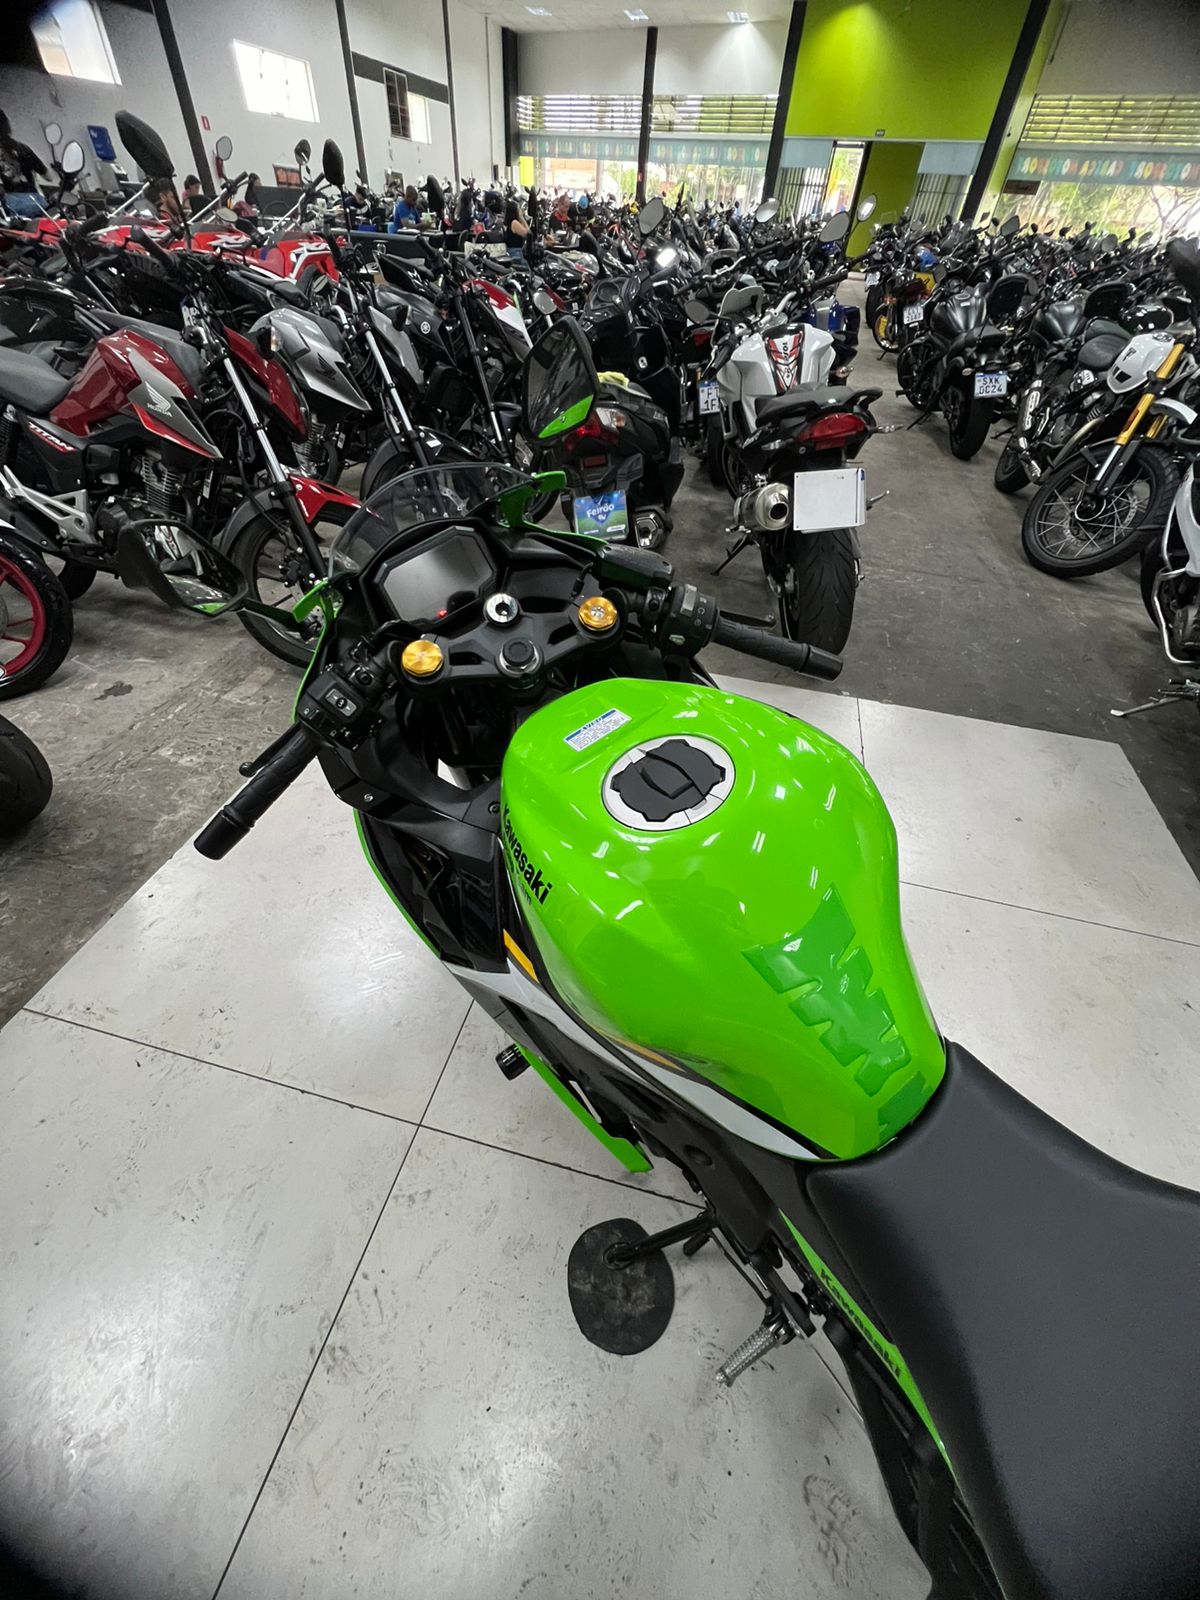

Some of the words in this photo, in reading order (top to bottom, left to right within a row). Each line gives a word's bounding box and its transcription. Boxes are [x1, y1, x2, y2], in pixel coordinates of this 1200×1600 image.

[982, 376, 1000, 385] SXK
[28, 421, 76, 452] TITAN
[586, 503, 615, 518] Feirão
[503, 802, 552, 905] Kawasaki
